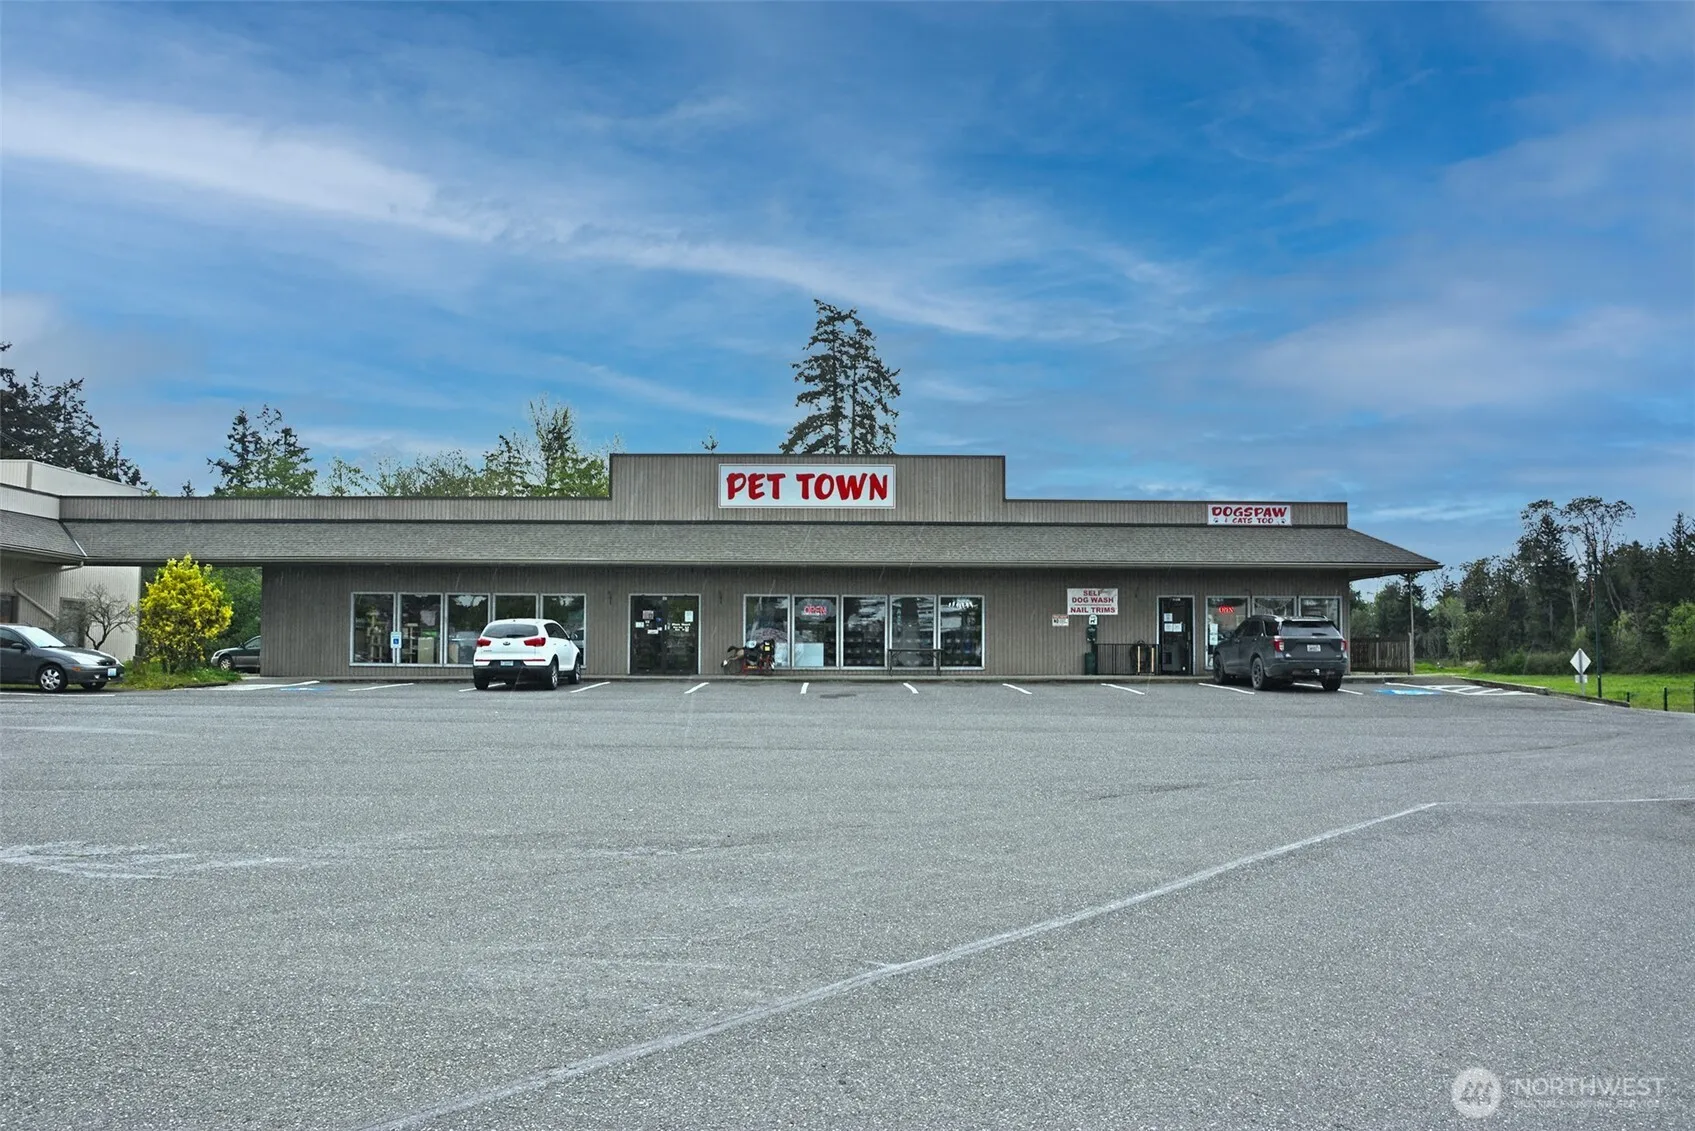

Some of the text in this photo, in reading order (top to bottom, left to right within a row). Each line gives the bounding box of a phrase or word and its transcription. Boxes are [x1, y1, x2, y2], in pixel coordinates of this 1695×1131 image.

[726, 472, 888, 501] PET TOWN
[1211, 506, 1288, 517] DOGSPAW
